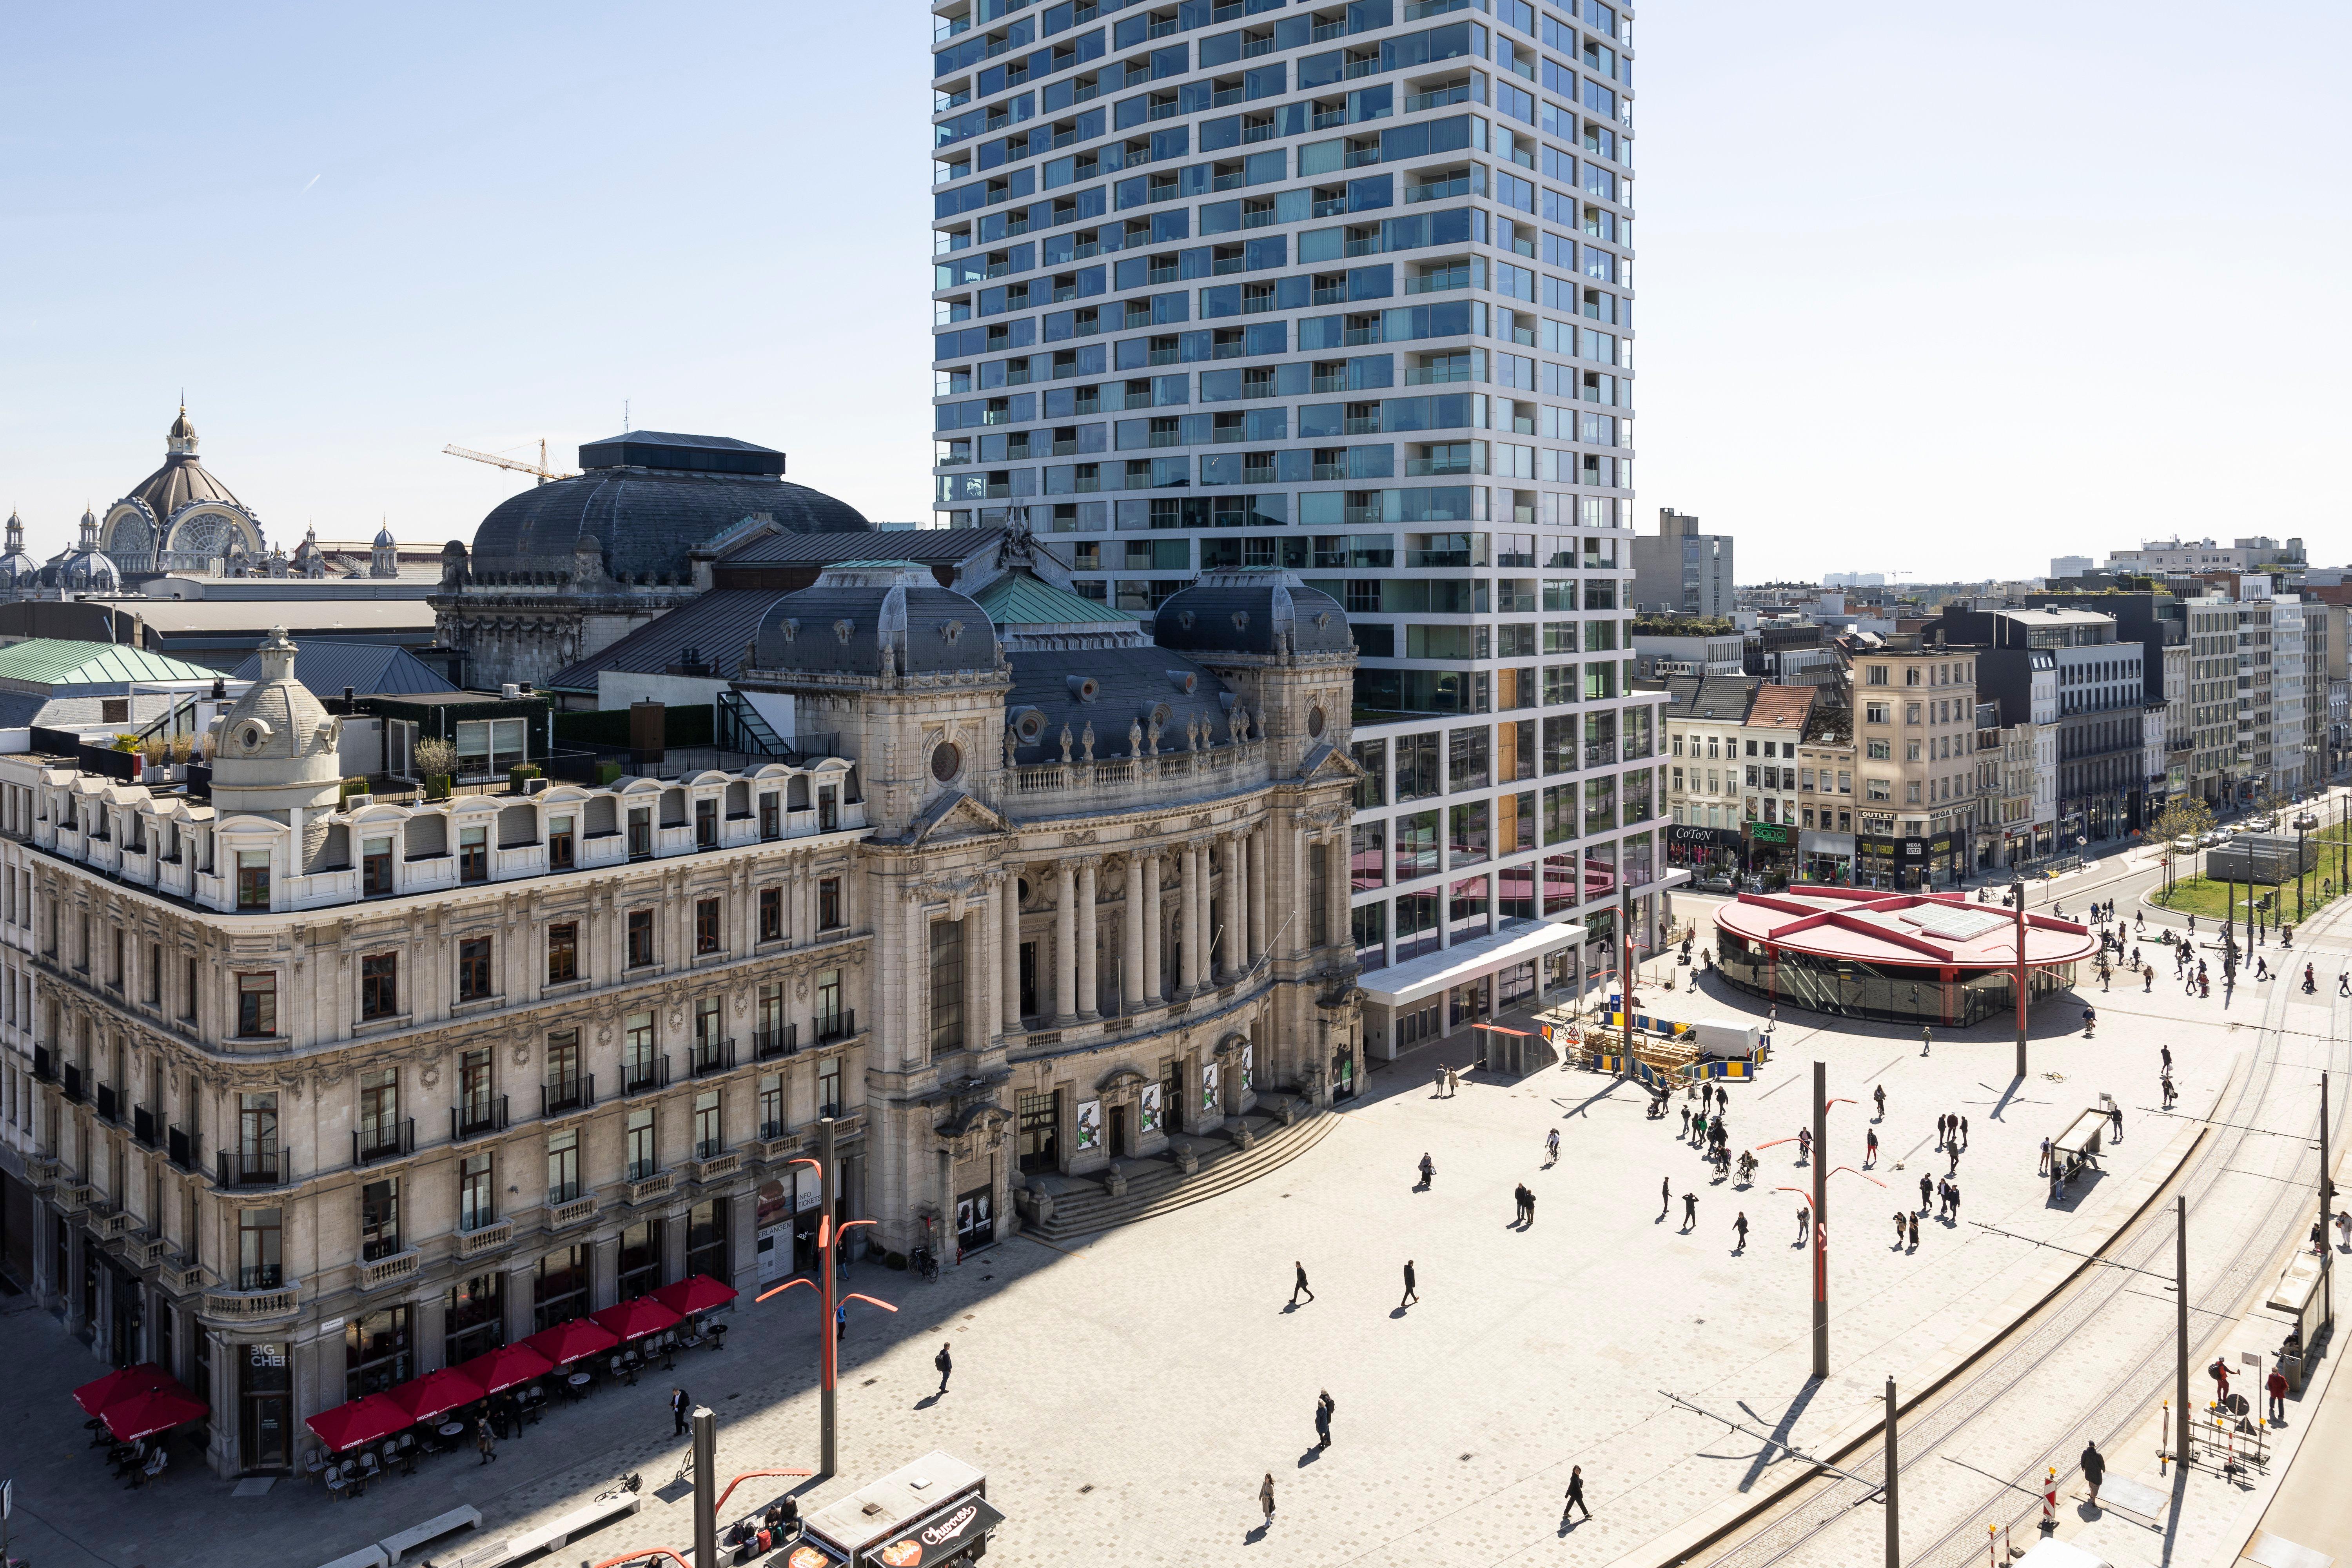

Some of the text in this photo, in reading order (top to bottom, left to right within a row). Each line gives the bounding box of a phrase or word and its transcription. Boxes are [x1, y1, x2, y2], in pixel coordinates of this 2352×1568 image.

[1955, 805, 1974, 813] OUTLET
[1930, 810, 1950, 820] MEGA
[1755, 827, 1784, 838] Sano
[1862, 843, 1873, 853] TOTAL
[798, 1191, 811, 1201] INFO
[798, 1195, 822, 1208] TICKETS
[251, 1345, 275, 1355] BIG
[561, 1354, 579, 1364] BIGCHEFS
[490, 1383, 510, 1394] BIGCHEFS
[417, 1410, 438, 1421] BIGCHEFS
[129, 1428, 153, 1440] BIGCHEFS
[341, 1438, 363, 1450] BIGCHEFS
[922, 1506, 977, 1545] Churros
[893, 1545, 920, 1566] Love
